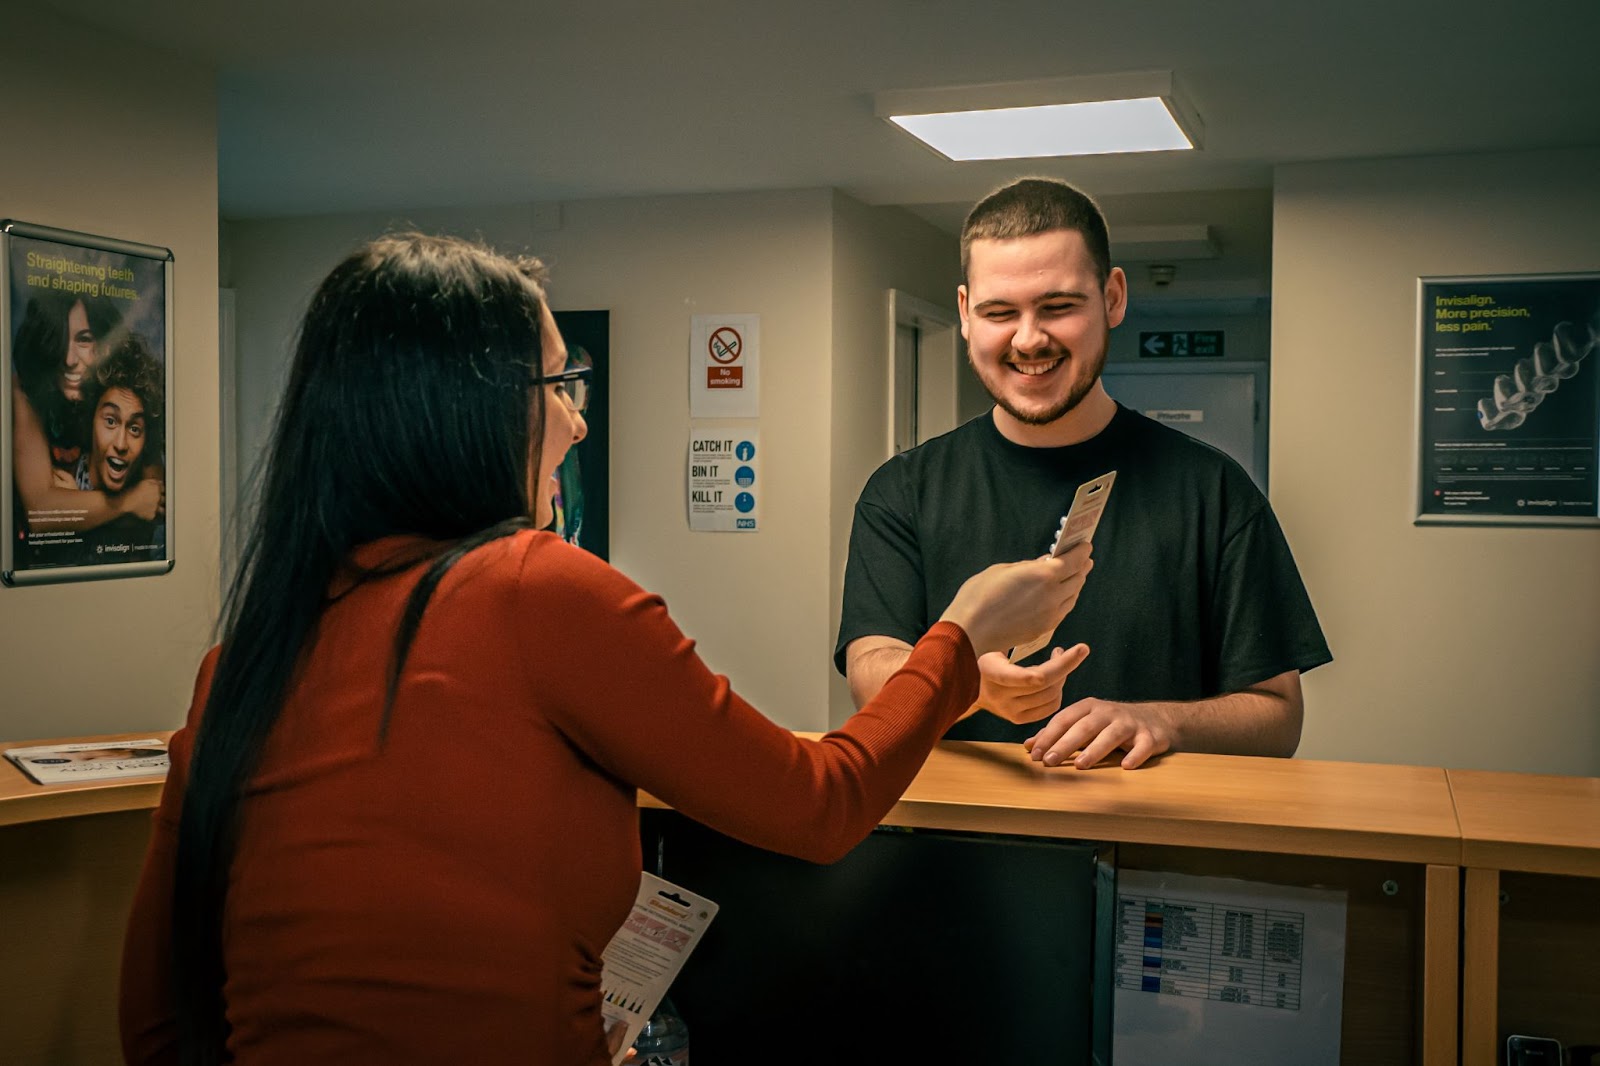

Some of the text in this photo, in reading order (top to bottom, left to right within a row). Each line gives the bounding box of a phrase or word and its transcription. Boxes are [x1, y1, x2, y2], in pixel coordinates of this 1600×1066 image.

[27, 252, 134, 281] Straightening teeth
[27, 274, 140, 300] and shaping futures.
[1436, 295, 1496, 307] Invisalign.
[1436, 306, 1530, 319] More precision,
[1435, 321, 1460, 332] less
[720, 368, 731, 376] No
[710, 378, 741, 386] smoking
[692, 440, 733, 452] CATCH IT
[692, 465, 719, 477] BIN IT
[692, 490, 723, 503] KILL IT
[104, 544, 130, 553] invisalign
